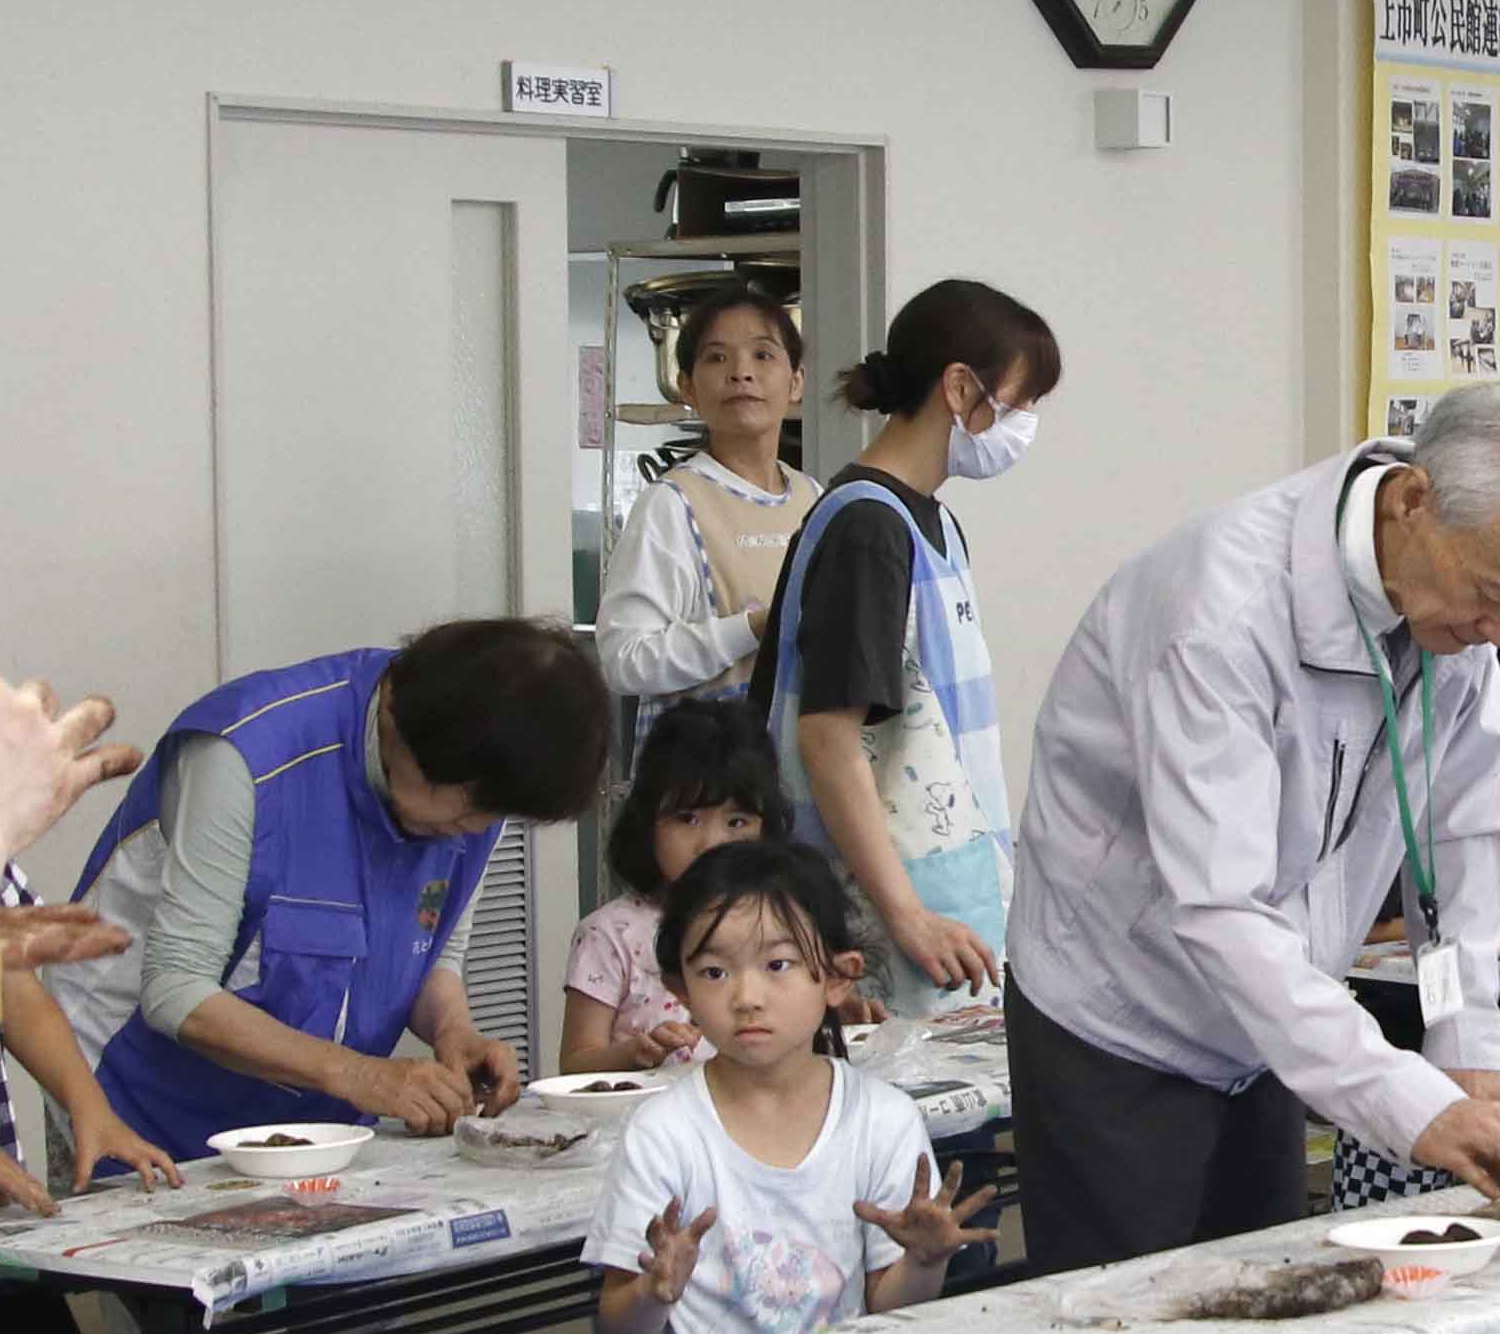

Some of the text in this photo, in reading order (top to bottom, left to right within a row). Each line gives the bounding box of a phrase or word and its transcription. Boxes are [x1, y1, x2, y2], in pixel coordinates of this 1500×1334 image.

[516, 75, 602, 106] 料理実習室
